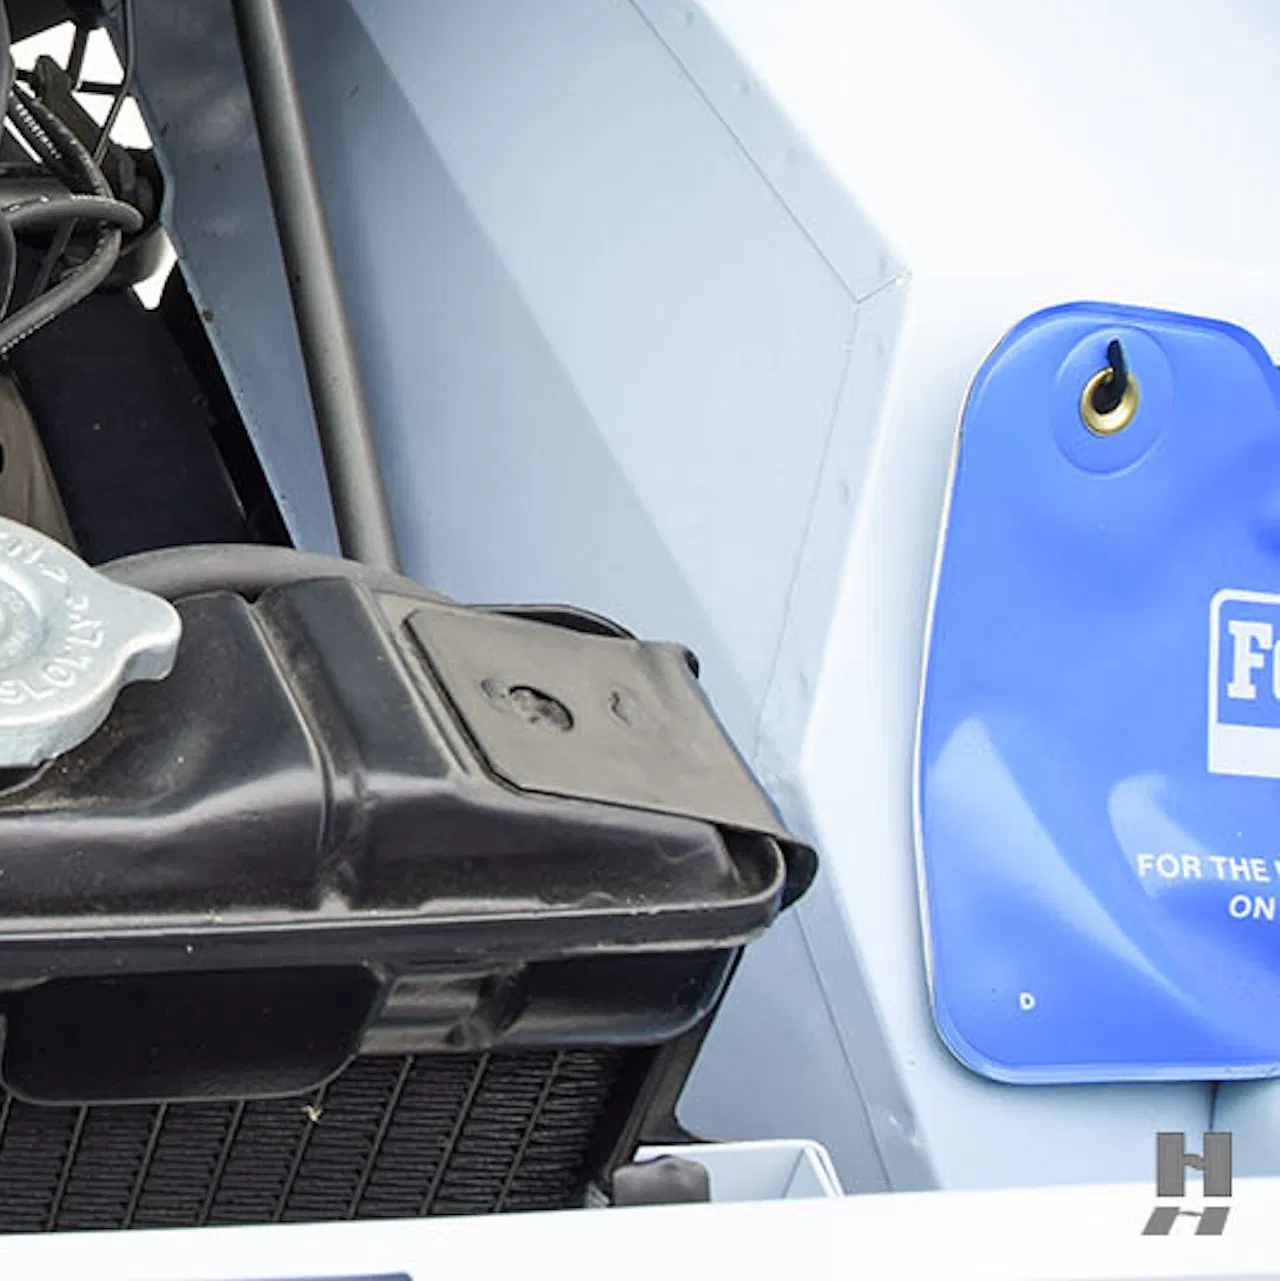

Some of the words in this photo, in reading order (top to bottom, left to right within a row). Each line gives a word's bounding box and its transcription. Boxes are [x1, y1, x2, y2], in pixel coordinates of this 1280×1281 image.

[1227, 620, 1280, 700] F
[1136, 852, 1203, 880] FOR
[1209, 855, 1271, 882] THE
[1228, 894, 1275, 921] ON
